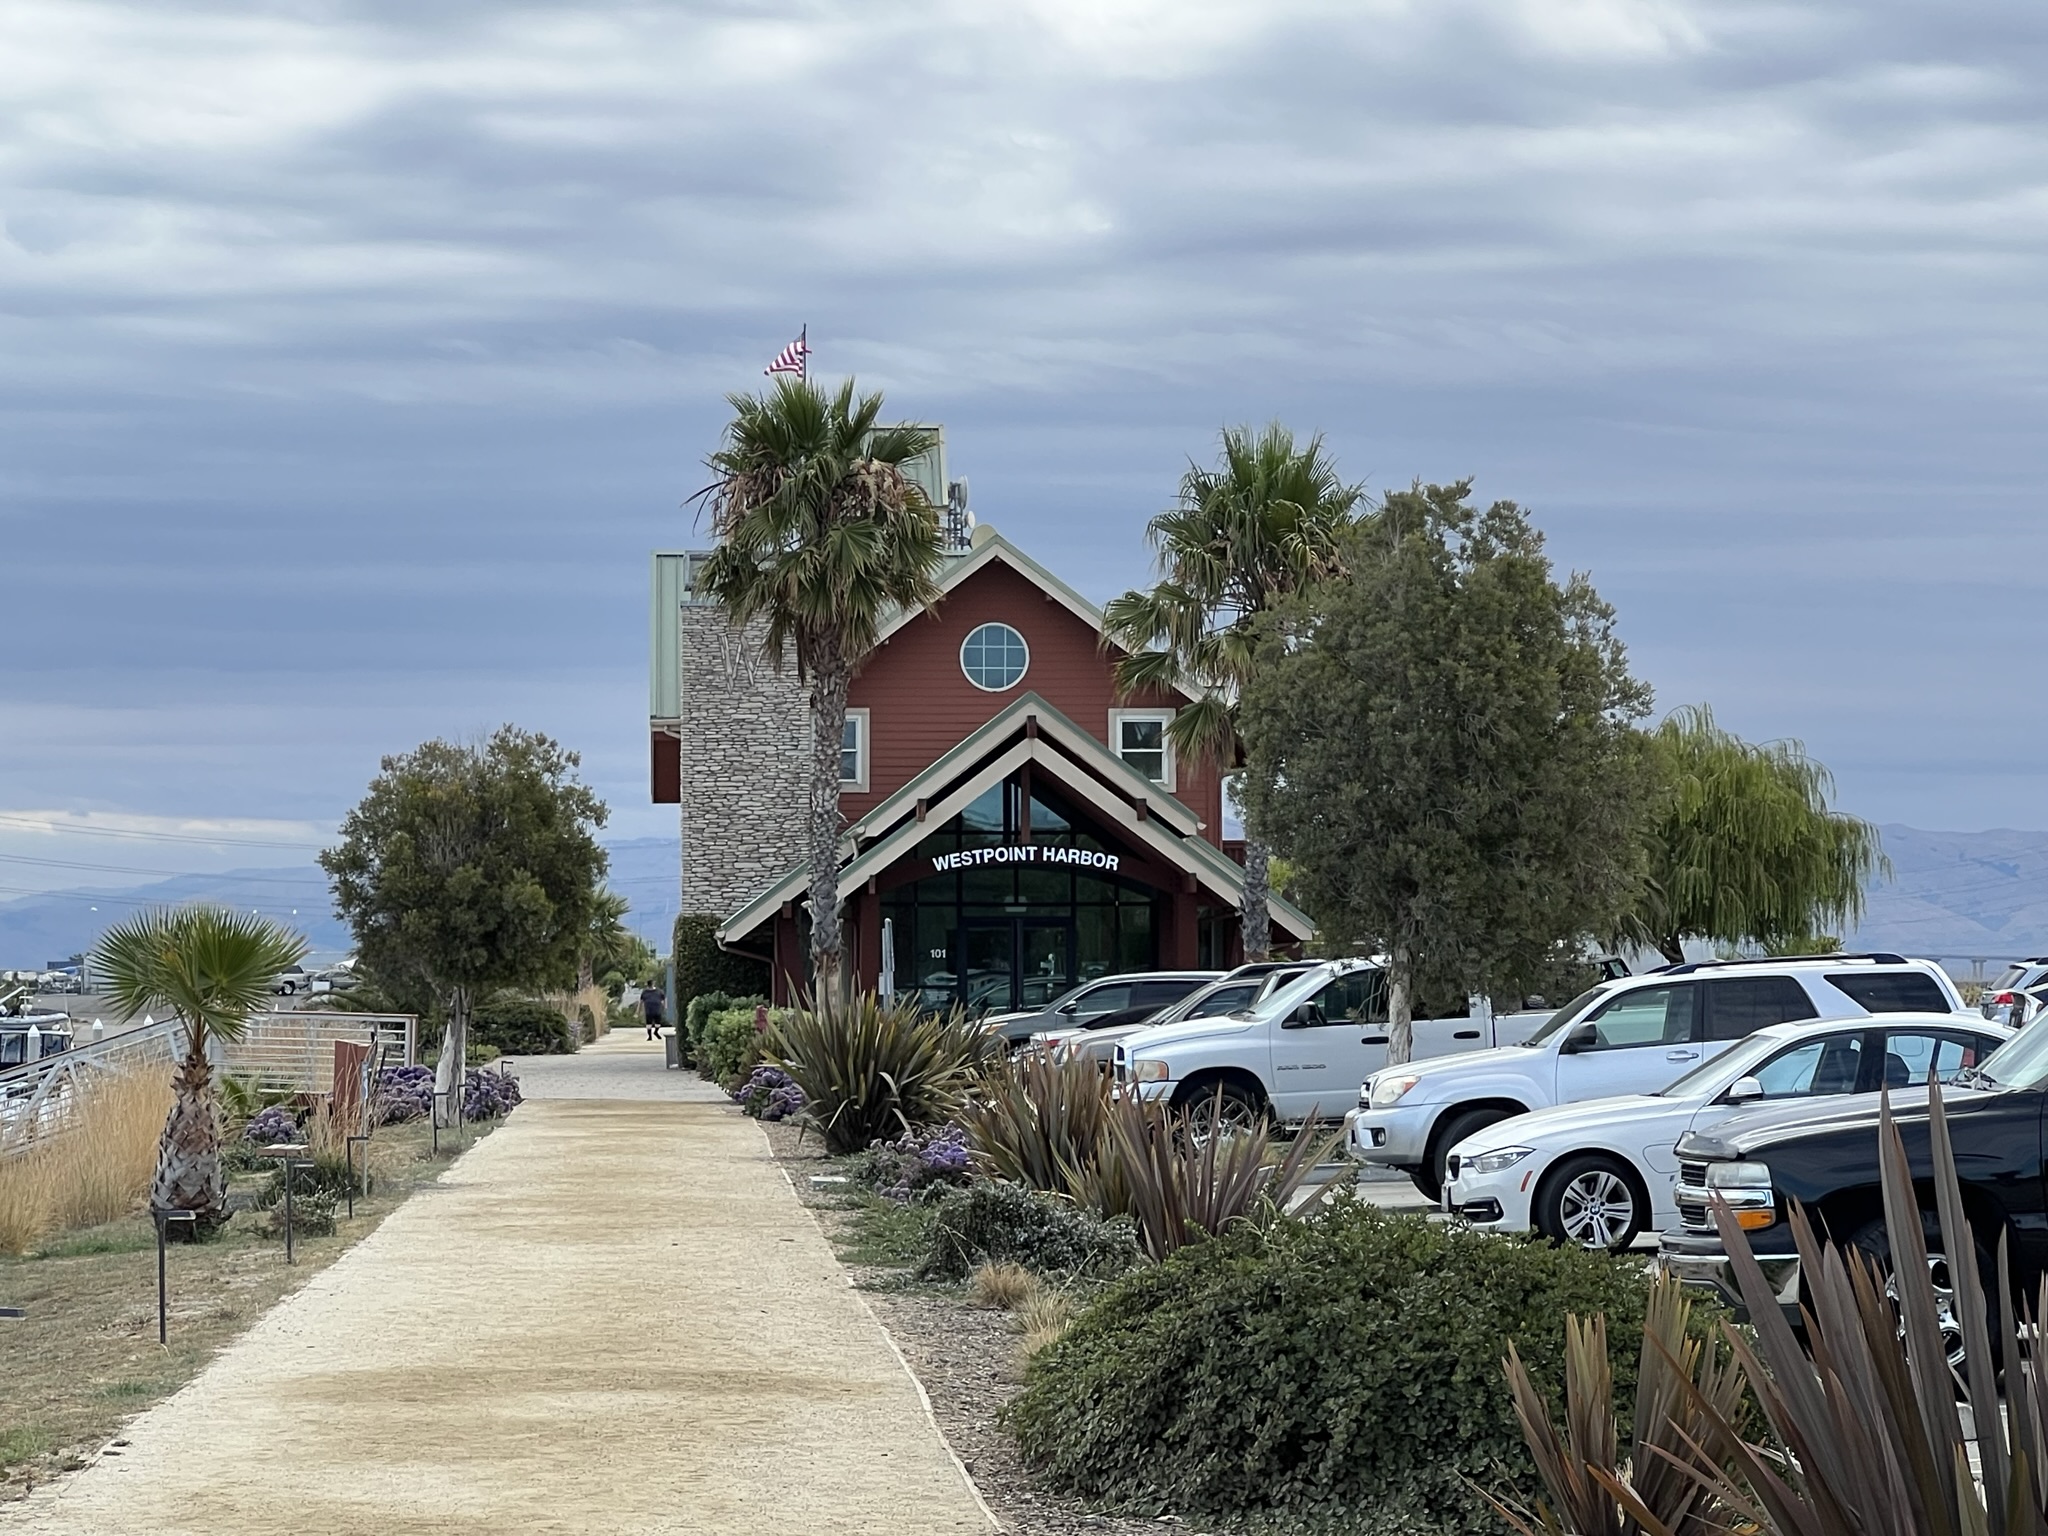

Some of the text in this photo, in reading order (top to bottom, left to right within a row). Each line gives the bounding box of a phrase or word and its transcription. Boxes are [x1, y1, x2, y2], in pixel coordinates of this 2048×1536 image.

[932, 846, 1119, 871] WESTPOINT HARBOR
[930, 949, 946, 958] 101
